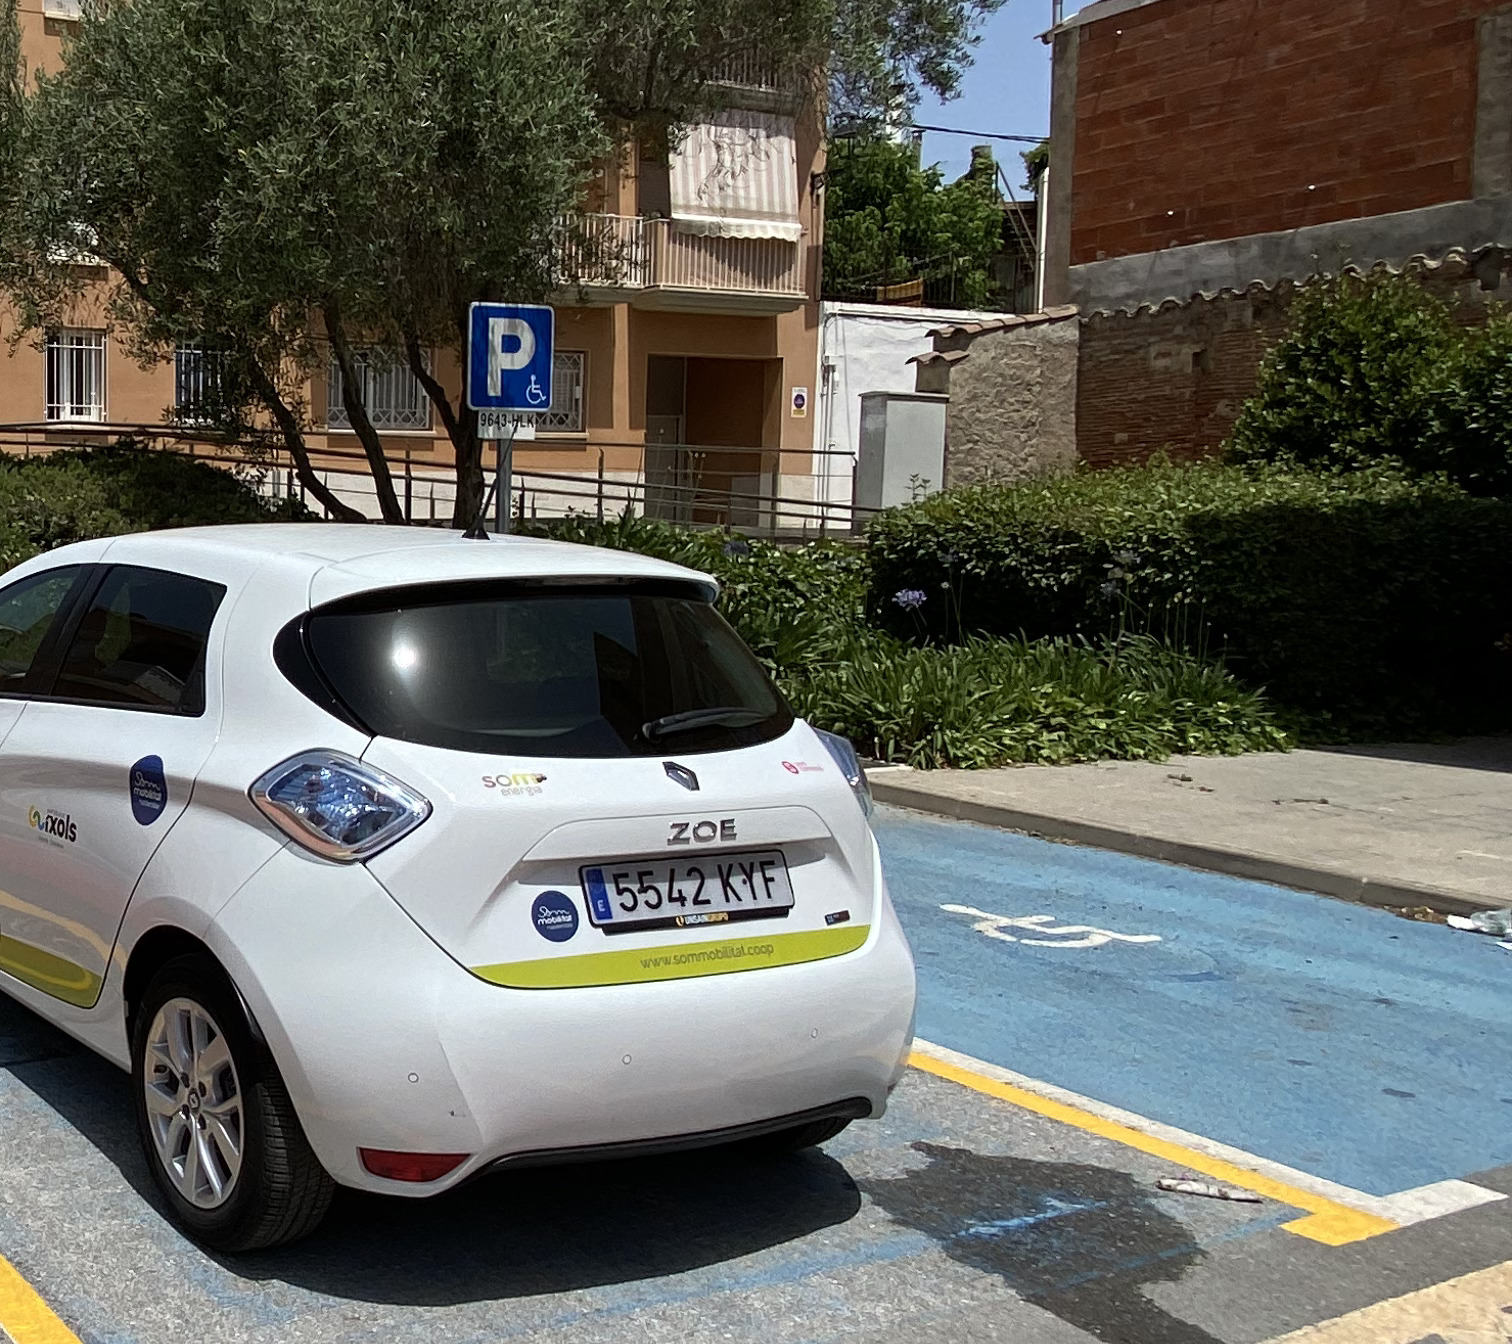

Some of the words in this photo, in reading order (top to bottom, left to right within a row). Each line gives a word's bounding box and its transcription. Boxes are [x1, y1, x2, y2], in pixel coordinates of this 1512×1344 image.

[488, 317, 536, 397] P
[667, 818, 737, 846] ZOE
[612, 866, 711, 912] 5542
[717, 860, 775, 903] KYF
